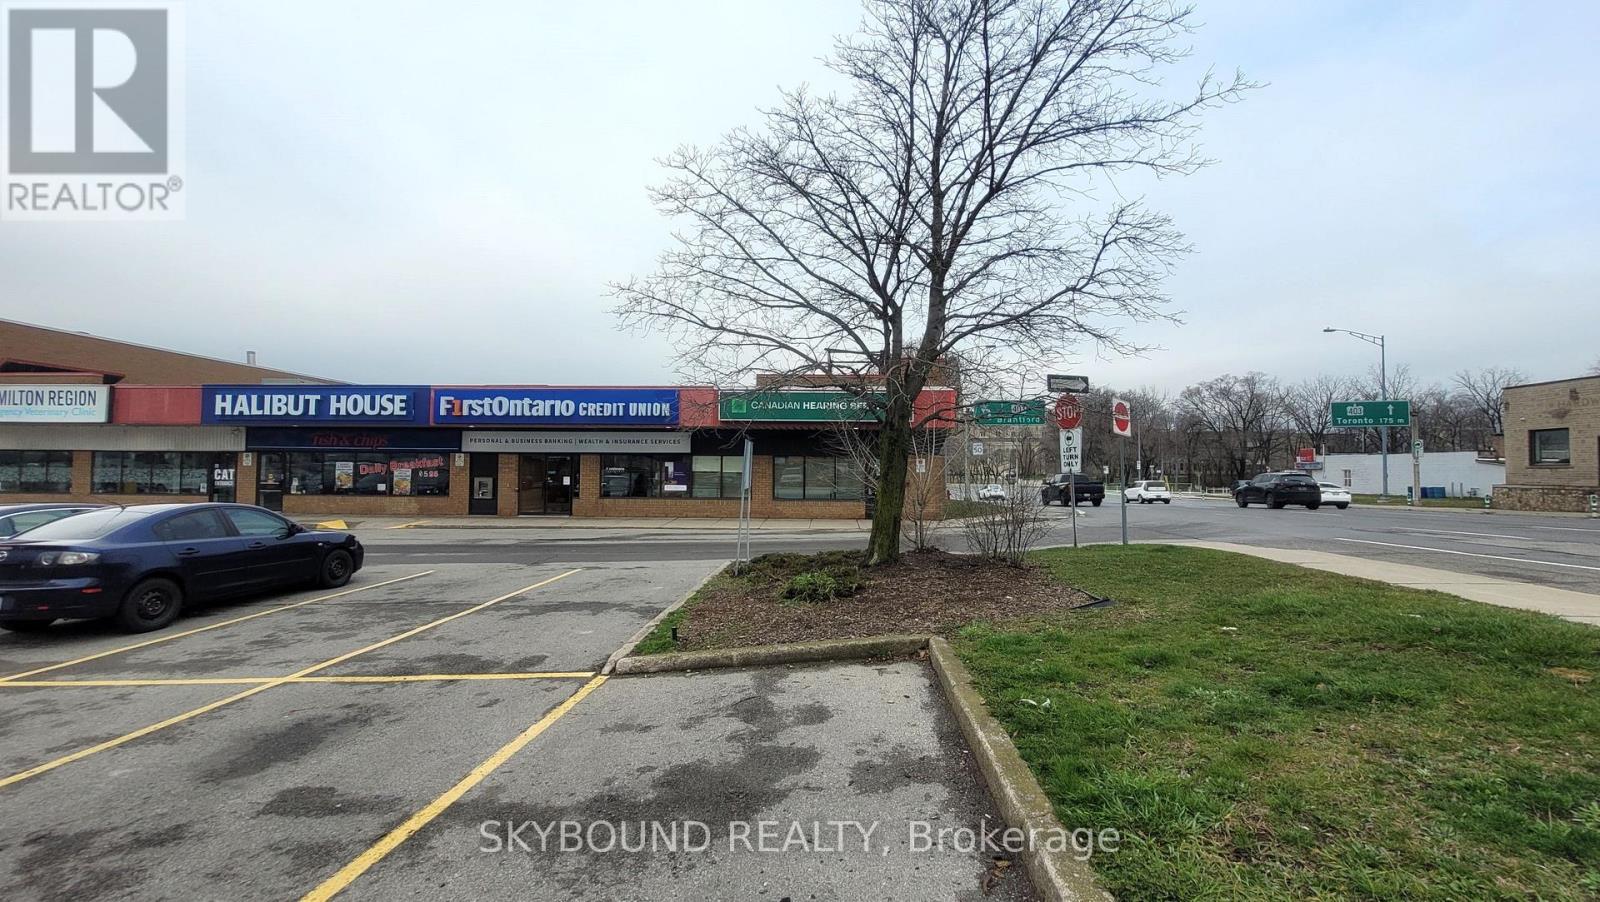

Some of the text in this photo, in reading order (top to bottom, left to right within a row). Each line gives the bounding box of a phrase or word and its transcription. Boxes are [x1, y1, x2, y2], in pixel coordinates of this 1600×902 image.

[48, 390, 96, 406] REGION
[215, 394, 407, 416] HALIBUT HOUSE
[751, 401, 800, 410] CANADIAN
[802, 401, 848, 410] HEARING
[71, 407, 97, 416] Clinic
[578, 402, 625, 417] CREDIT
[629, 402, 671, 417] UNION
[1056, 405, 1081, 421] STOP
[1063, 446, 1077, 454] LEFT
[360, 463, 388, 476] Daily
[390, 456, 444, 472] Breakfast
[214, 468, 235, 480] CAT
